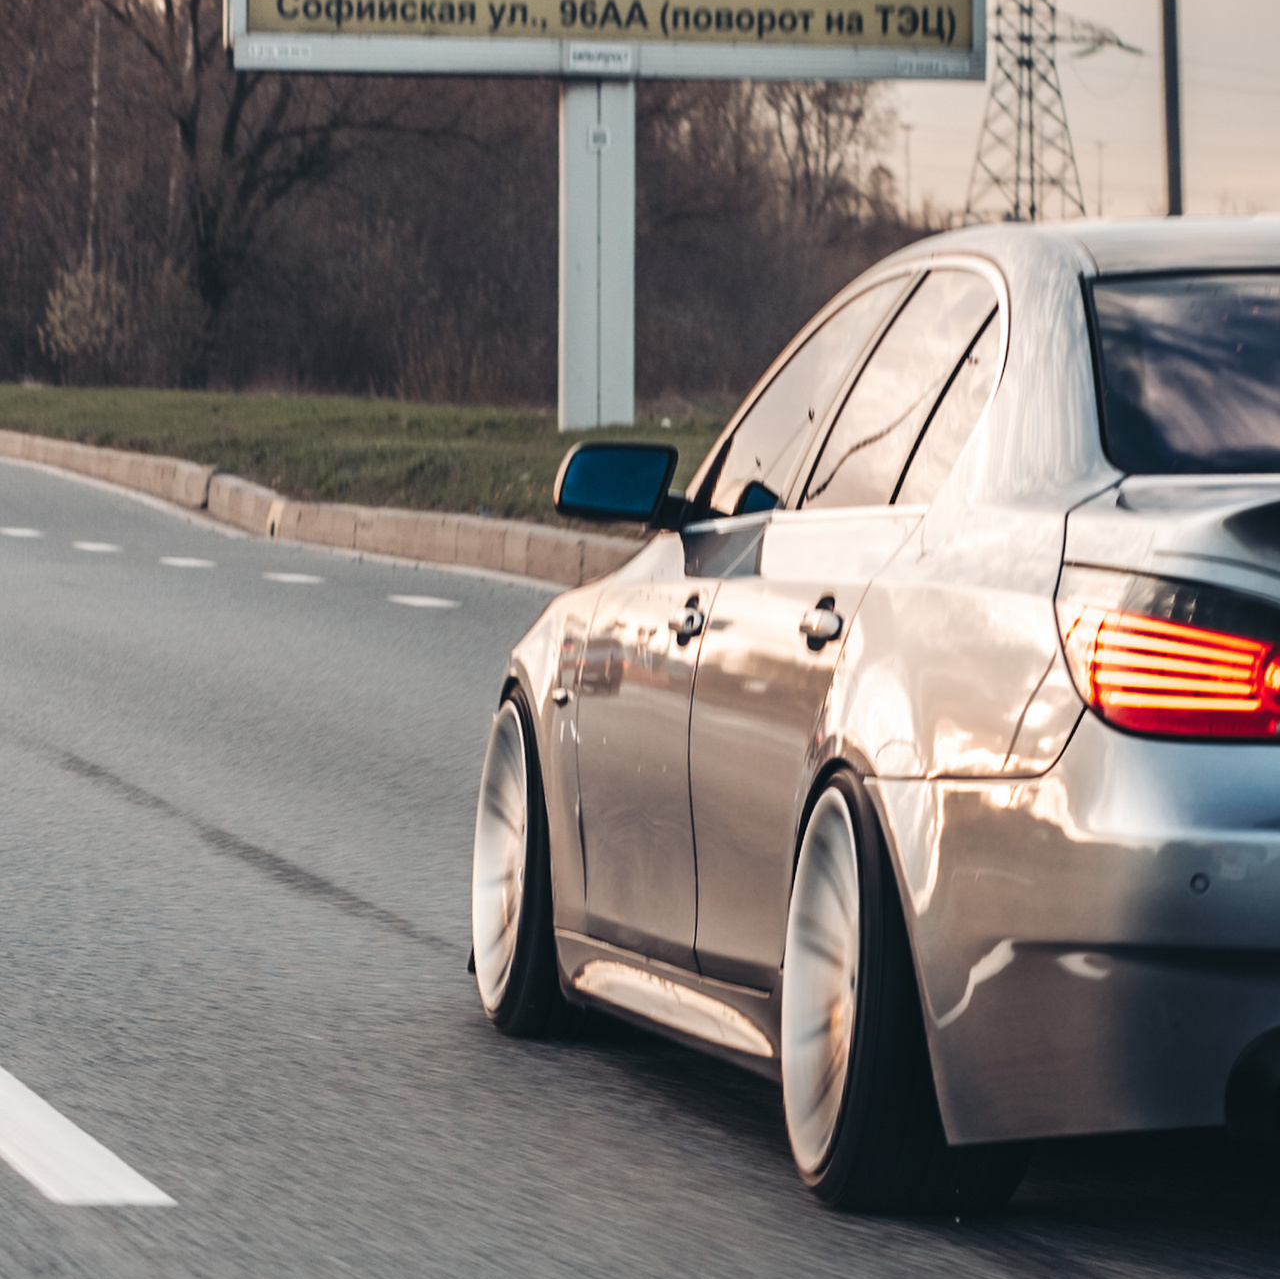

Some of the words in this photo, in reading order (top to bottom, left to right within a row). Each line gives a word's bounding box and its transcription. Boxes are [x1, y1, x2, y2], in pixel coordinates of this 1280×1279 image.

[488, 0, 548, 33] ул.,
[661, 0, 814, 39] (поворот
[826, 8, 864, 36] на
[876, 4, 956, 46] ТЭЦ)
